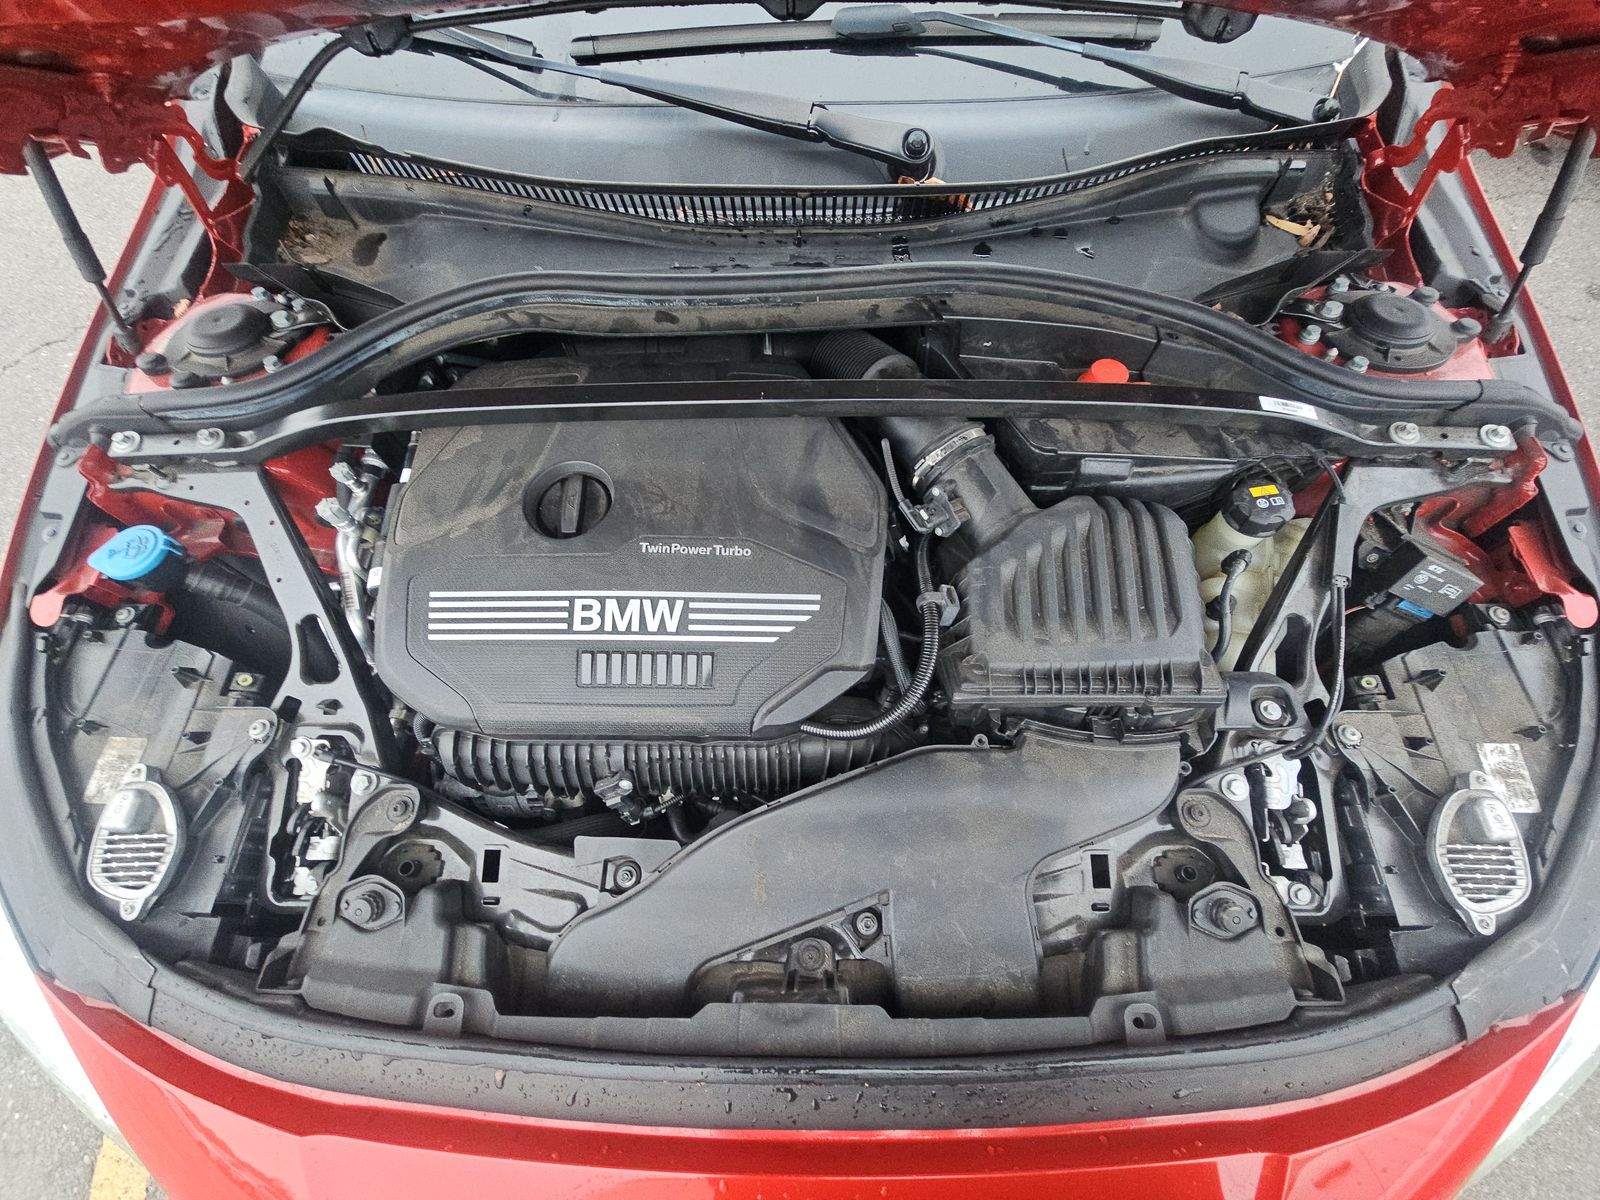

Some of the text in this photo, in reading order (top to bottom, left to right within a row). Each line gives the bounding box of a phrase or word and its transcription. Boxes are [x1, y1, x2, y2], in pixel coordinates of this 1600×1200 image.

[640, 542, 752, 557] TwinPower Turbo
[573, 598, 685, 632] BMW
